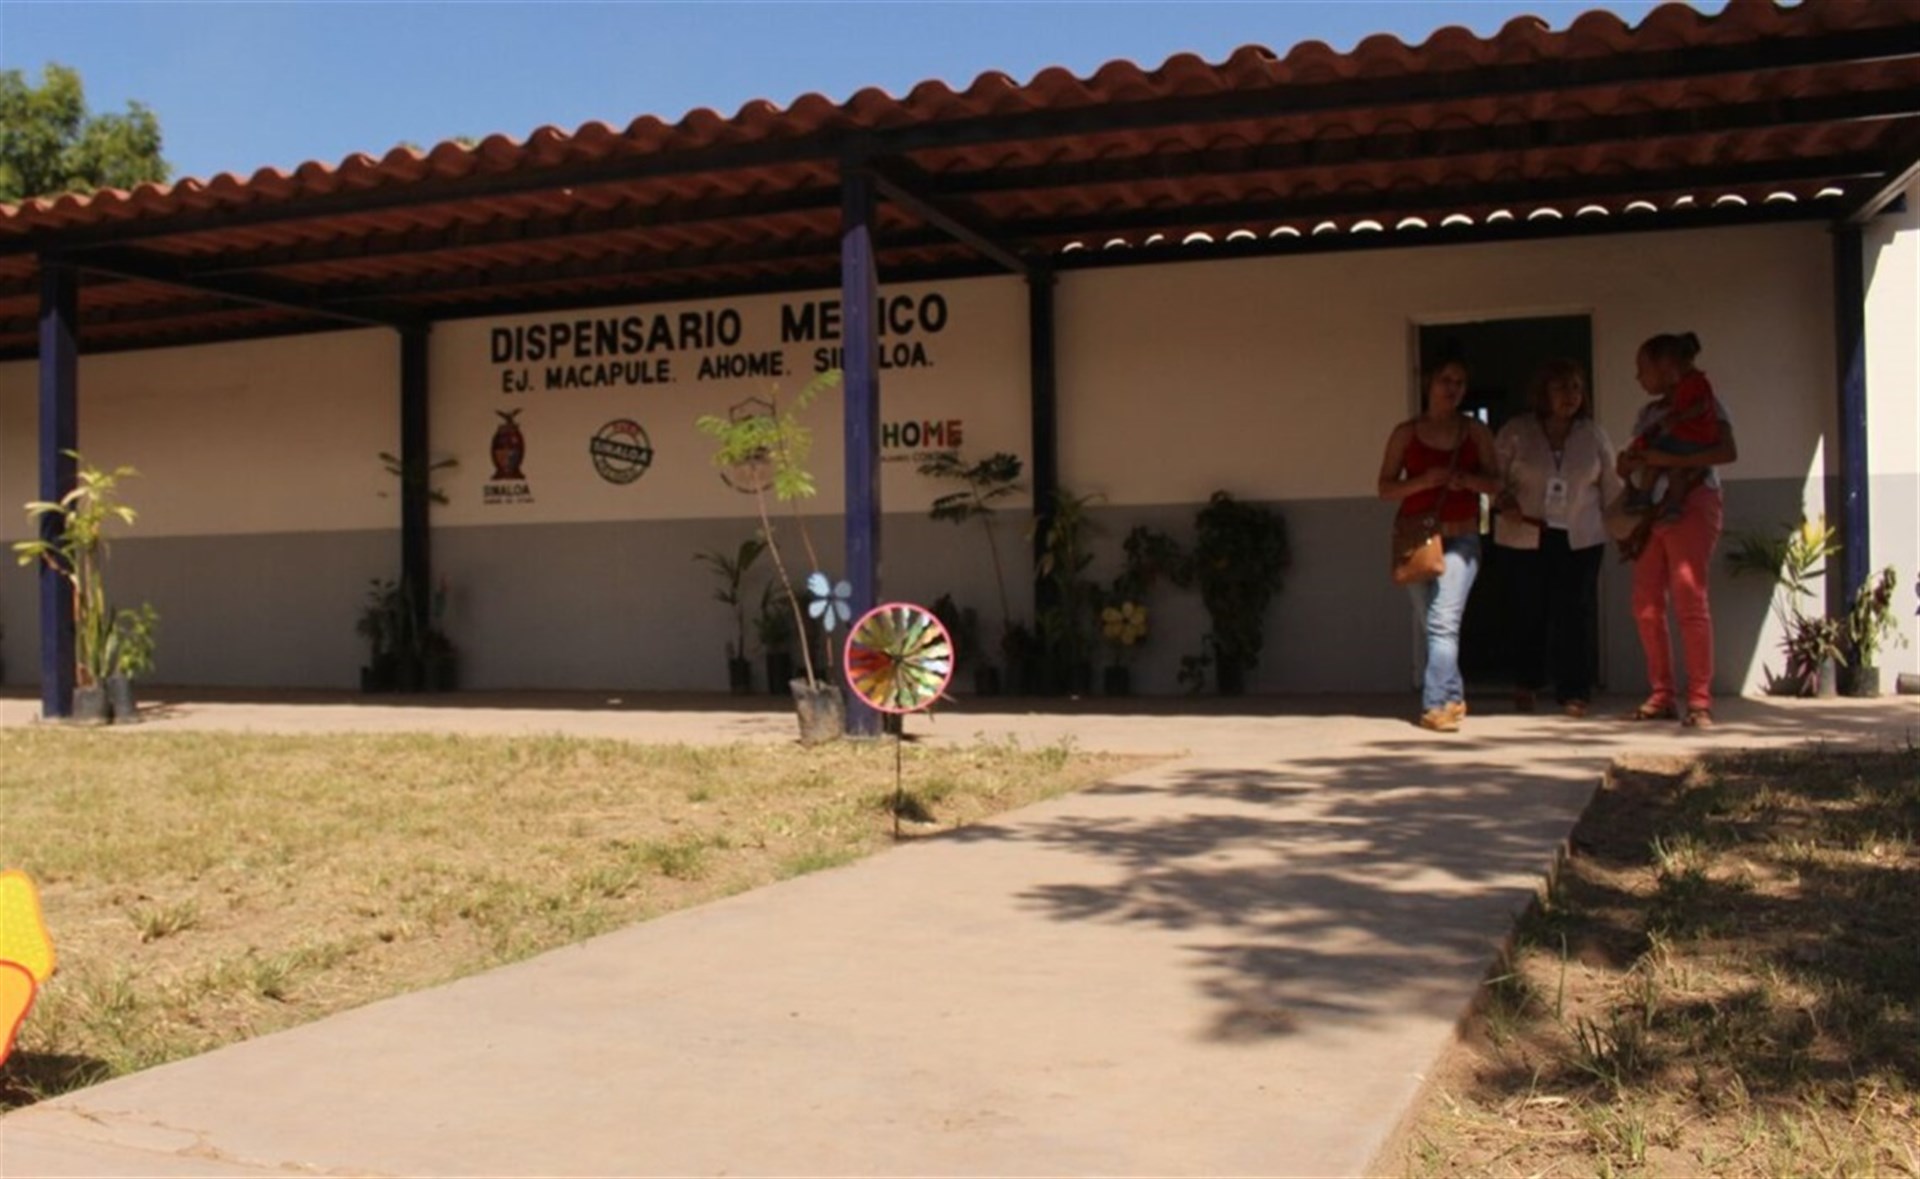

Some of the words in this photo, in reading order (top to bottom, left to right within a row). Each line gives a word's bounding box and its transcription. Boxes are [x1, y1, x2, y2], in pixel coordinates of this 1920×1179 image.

[491, 308, 742, 364] DISPENSARIO
[781, 293, 948, 343] MEICO
[502, 368, 535, 394] EJ.
[545, 359, 677, 391] MACAPULE.
[697, 350, 792, 381] AHOME.
[814, 341, 934, 374] SILOA.
[882, 418, 963, 449] HOME
